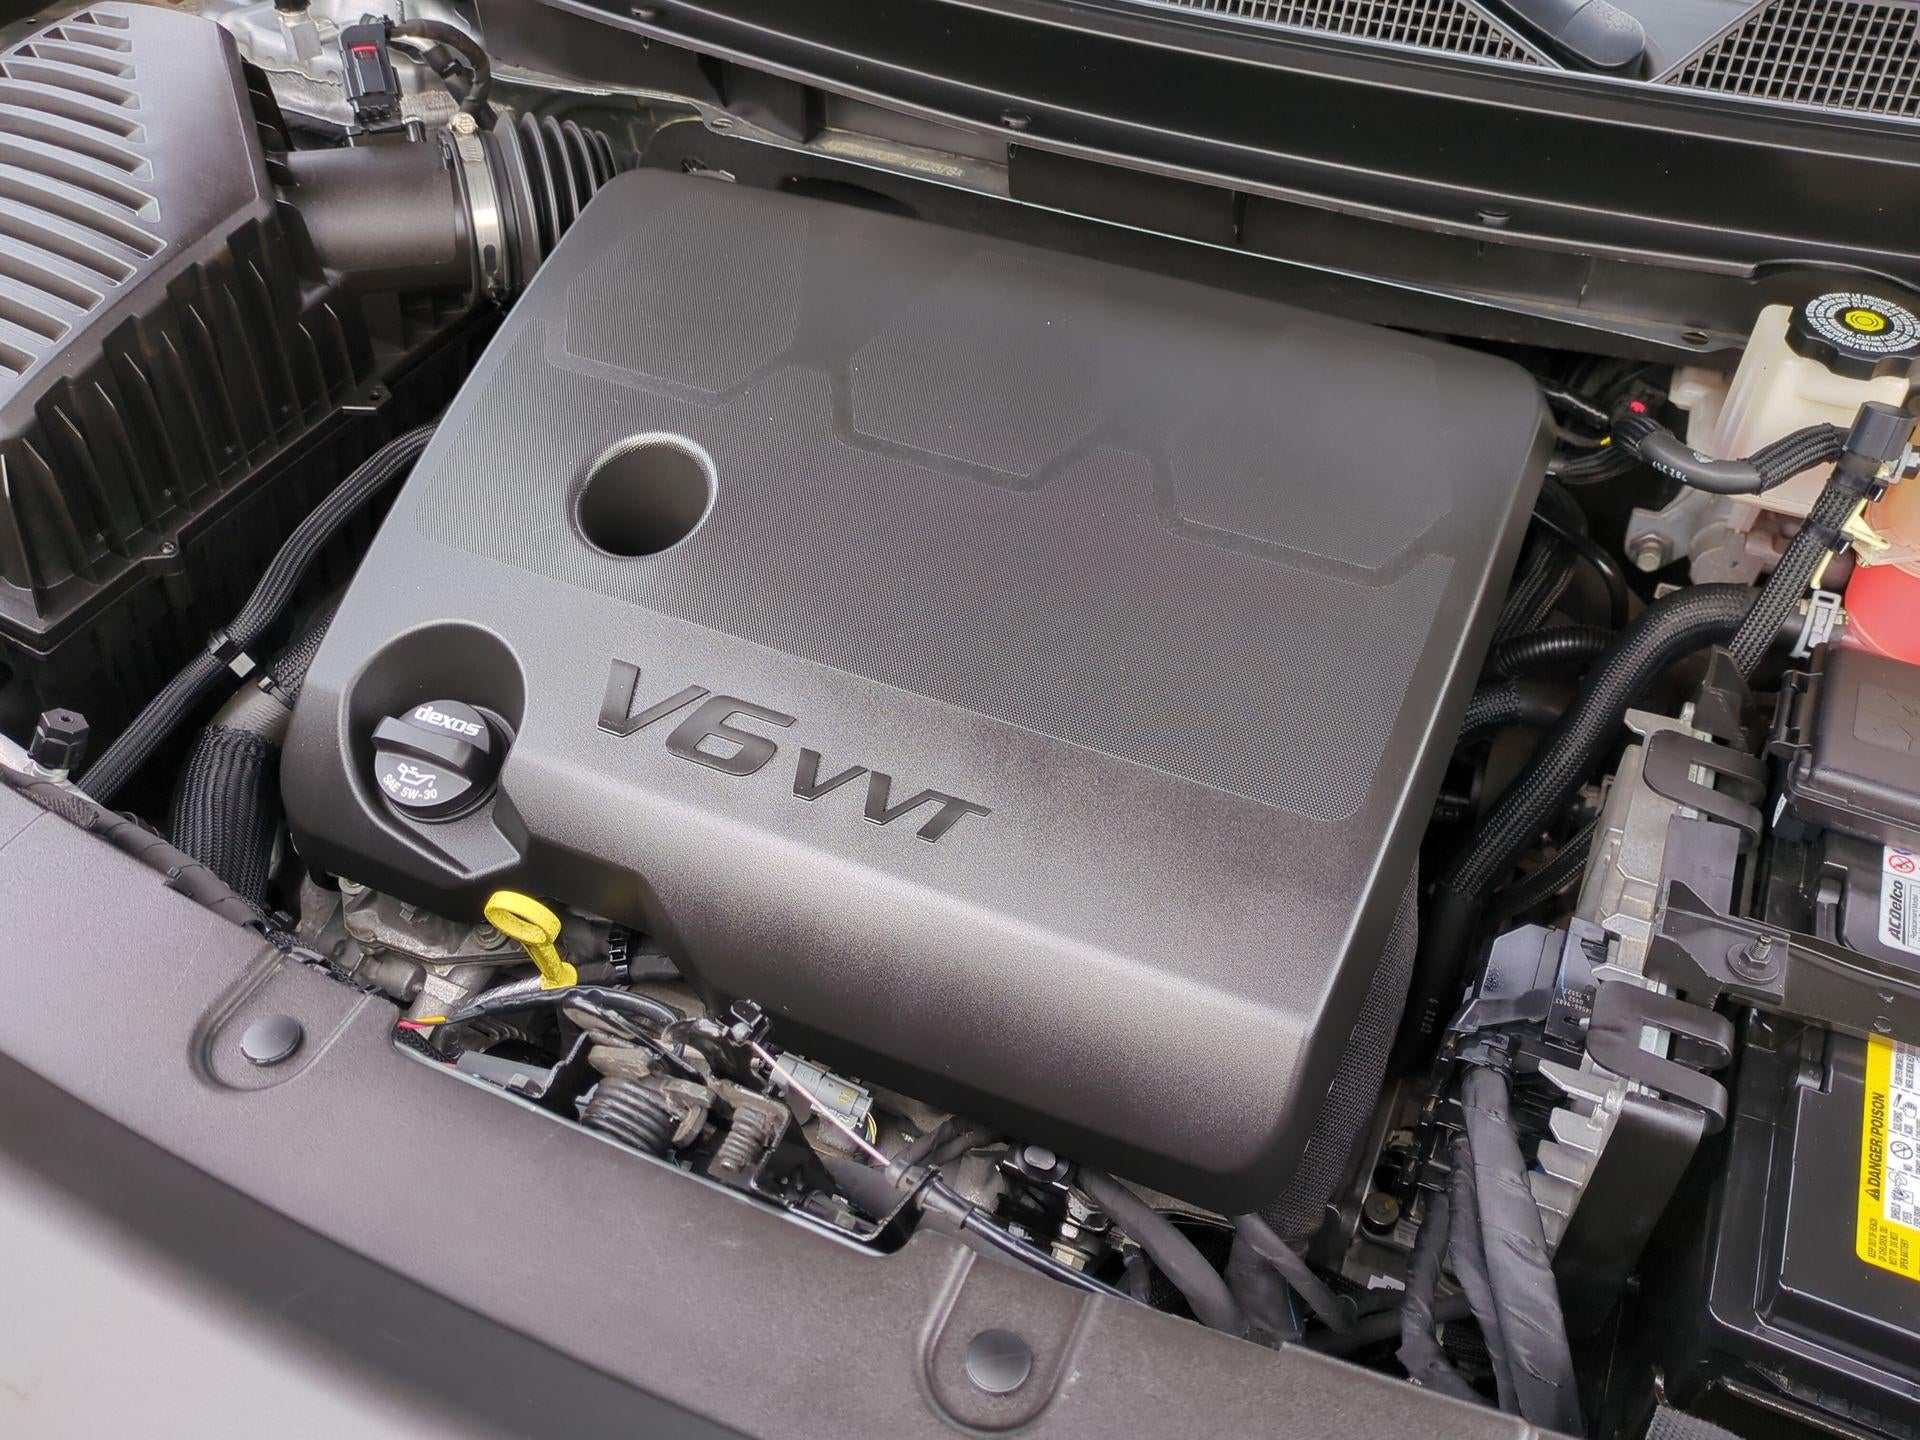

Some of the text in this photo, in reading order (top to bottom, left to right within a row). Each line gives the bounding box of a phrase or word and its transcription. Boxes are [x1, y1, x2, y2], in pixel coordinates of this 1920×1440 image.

[1857, 333, 1881, 341] CLEAN
[414, 706, 484, 736] dexos
[597, 658, 992, 843] V6 VVT
[383, 773, 437, 800] SAE 5W-30
[1888, 880, 1903, 941] ACDelco
[1867, 1092, 1885, 1187] DANGER/POISON
